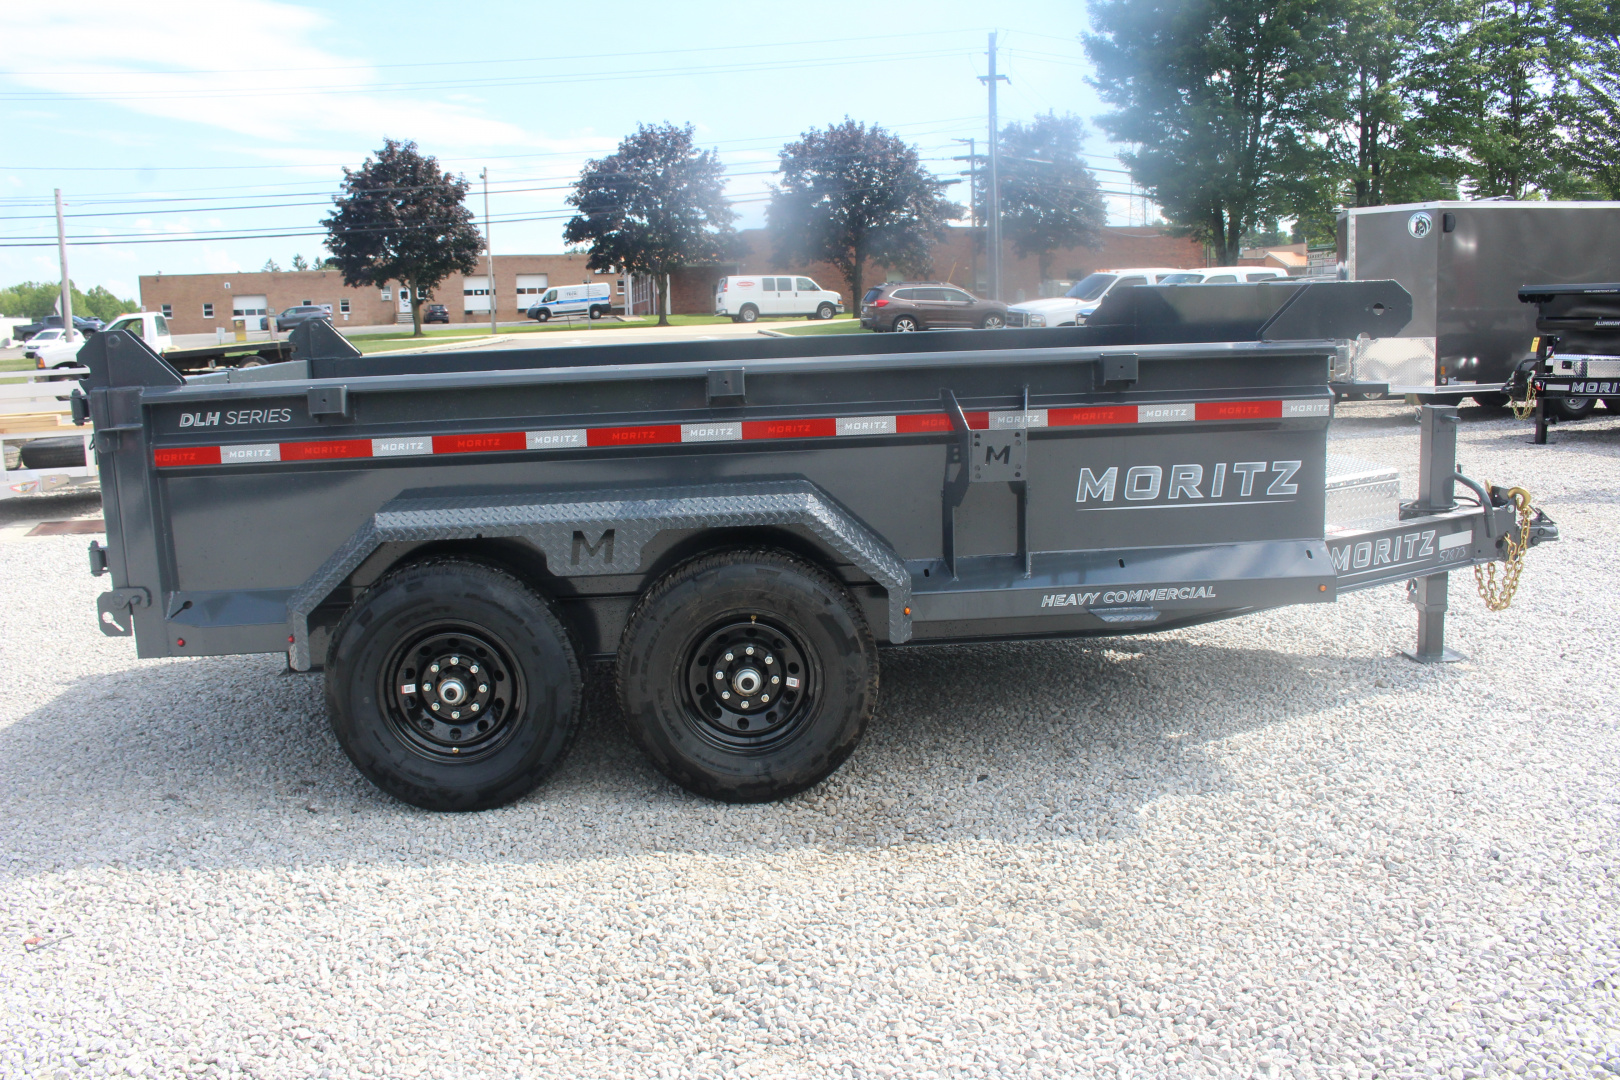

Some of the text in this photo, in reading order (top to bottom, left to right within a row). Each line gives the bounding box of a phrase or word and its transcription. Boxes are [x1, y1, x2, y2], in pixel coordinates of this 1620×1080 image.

[1571, 382, 1620, 393] MORI
[179, 408, 292, 427] DLH SERIES
[229, 449, 272, 458] MORITZ
[304, 445, 347, 455] MORITZ
[381, 442, 424, 451] MORITZ
[457, 438, 500, 448] MORITZ
[535, 434, 578, 444] MORITZ
[612, 431, 656, 440] MORITZ
[690, 428, 733, 437] MORITZ
[768, 424, 811, 434] MORITZ
[844, 421, 888, 430] MORITZ
[921, 418, 950, 427] MORI
[997, 415, 1040, 424] MORITZ
[1073, 411, 1115, 420] MORITZ
[1146, 408, 1187, 417] MORITZ
[1219, 406, 1259, 415] MORITZ
[1290, 404, 1329, 412] MORITZ
[985, 445, 1011, 465] M
[1076, 460, 1302, 502] MORITZ
[571, 529, 615, 565] M
[1331, 530, 1435, 571] MORITZ
[1041, 586, 1216, 607] HEAVY COMMERCIAL
